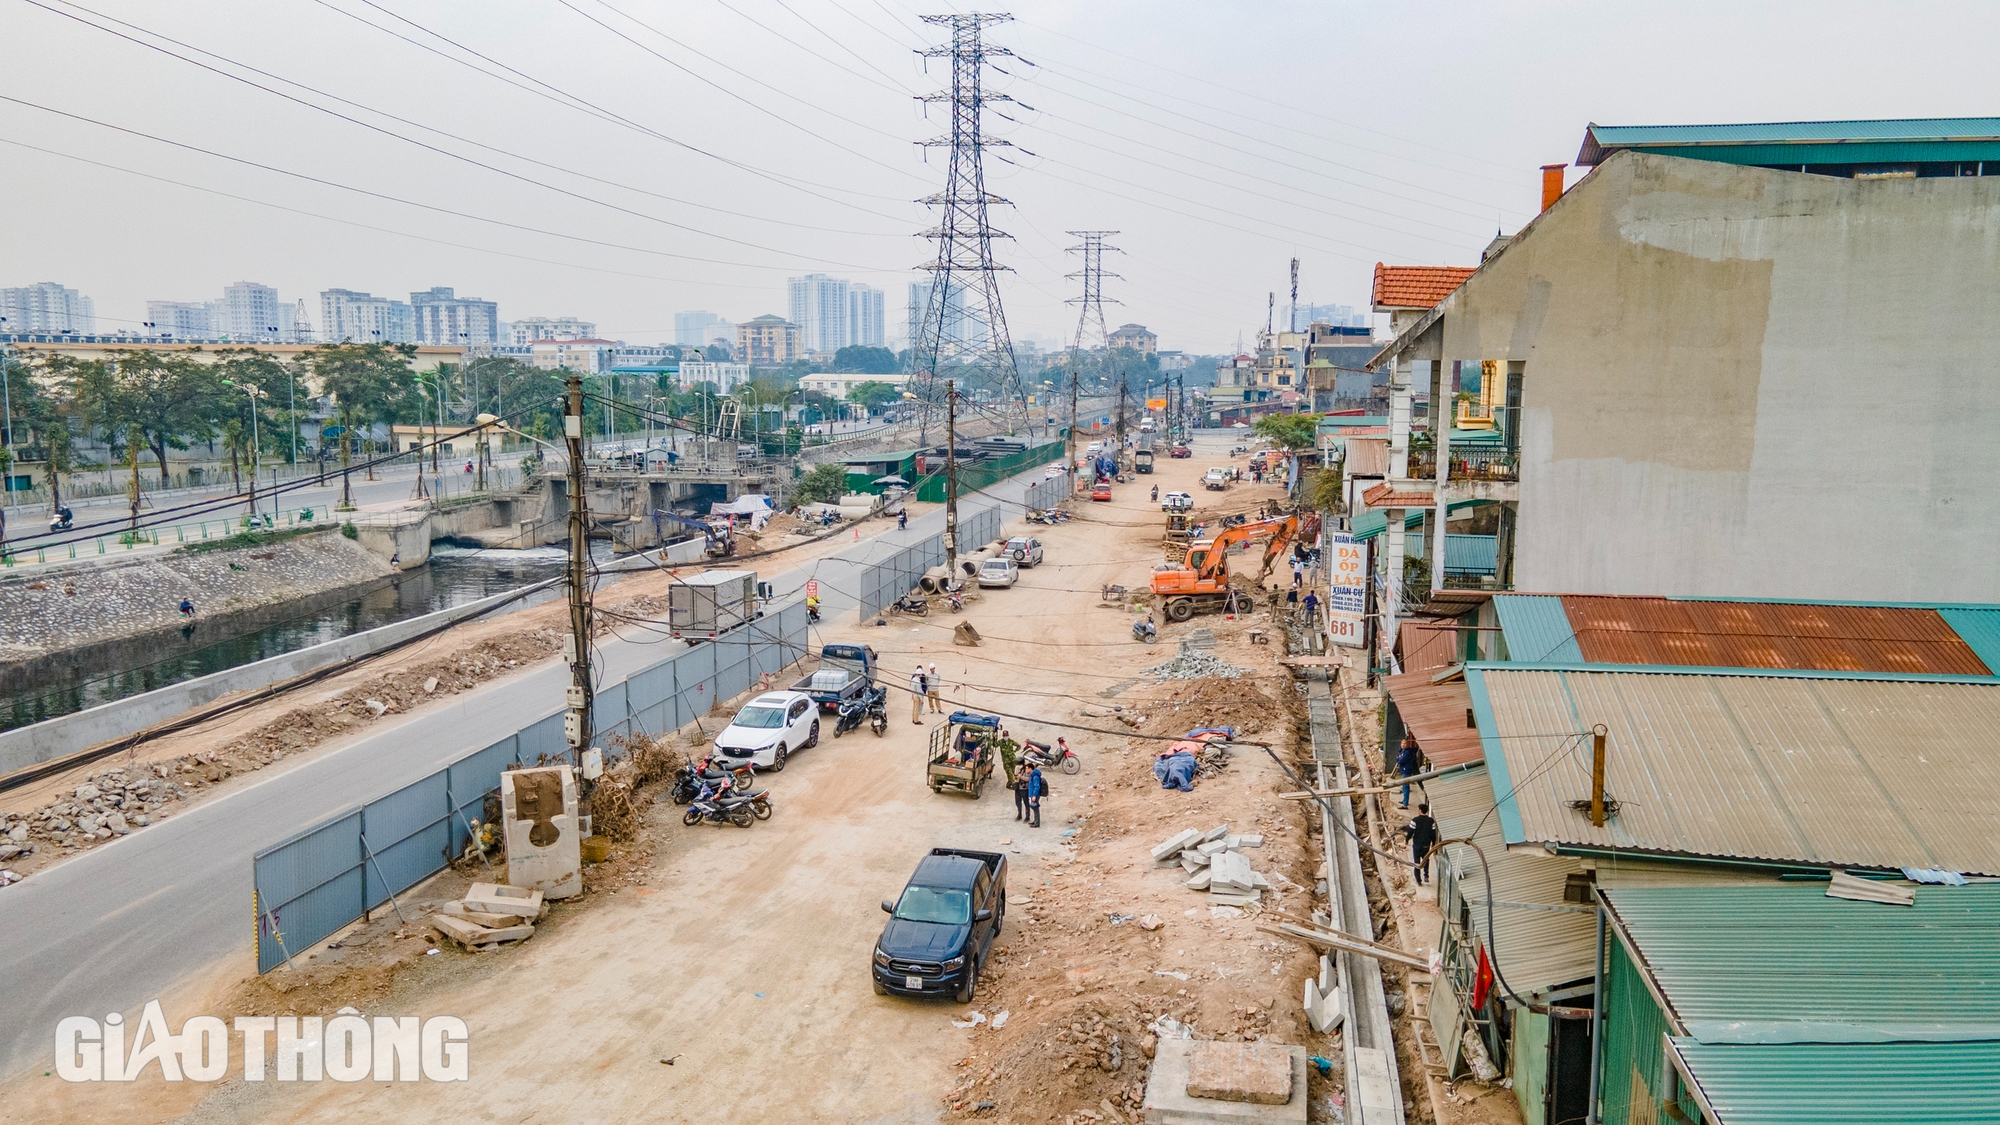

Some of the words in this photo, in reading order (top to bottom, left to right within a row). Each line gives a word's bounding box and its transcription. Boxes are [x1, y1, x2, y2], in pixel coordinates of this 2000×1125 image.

[1334, 534, 1350, 544] XUÂN
[1338, 546, 1360, 559] ĐÁ
[1339, 557, 1359, 572] ỐP
[1334, 573, 1363, 586] LÁT
[1332, 586, 1351, 596] XUÂN
[1330, 620, 1355, 637] 681
